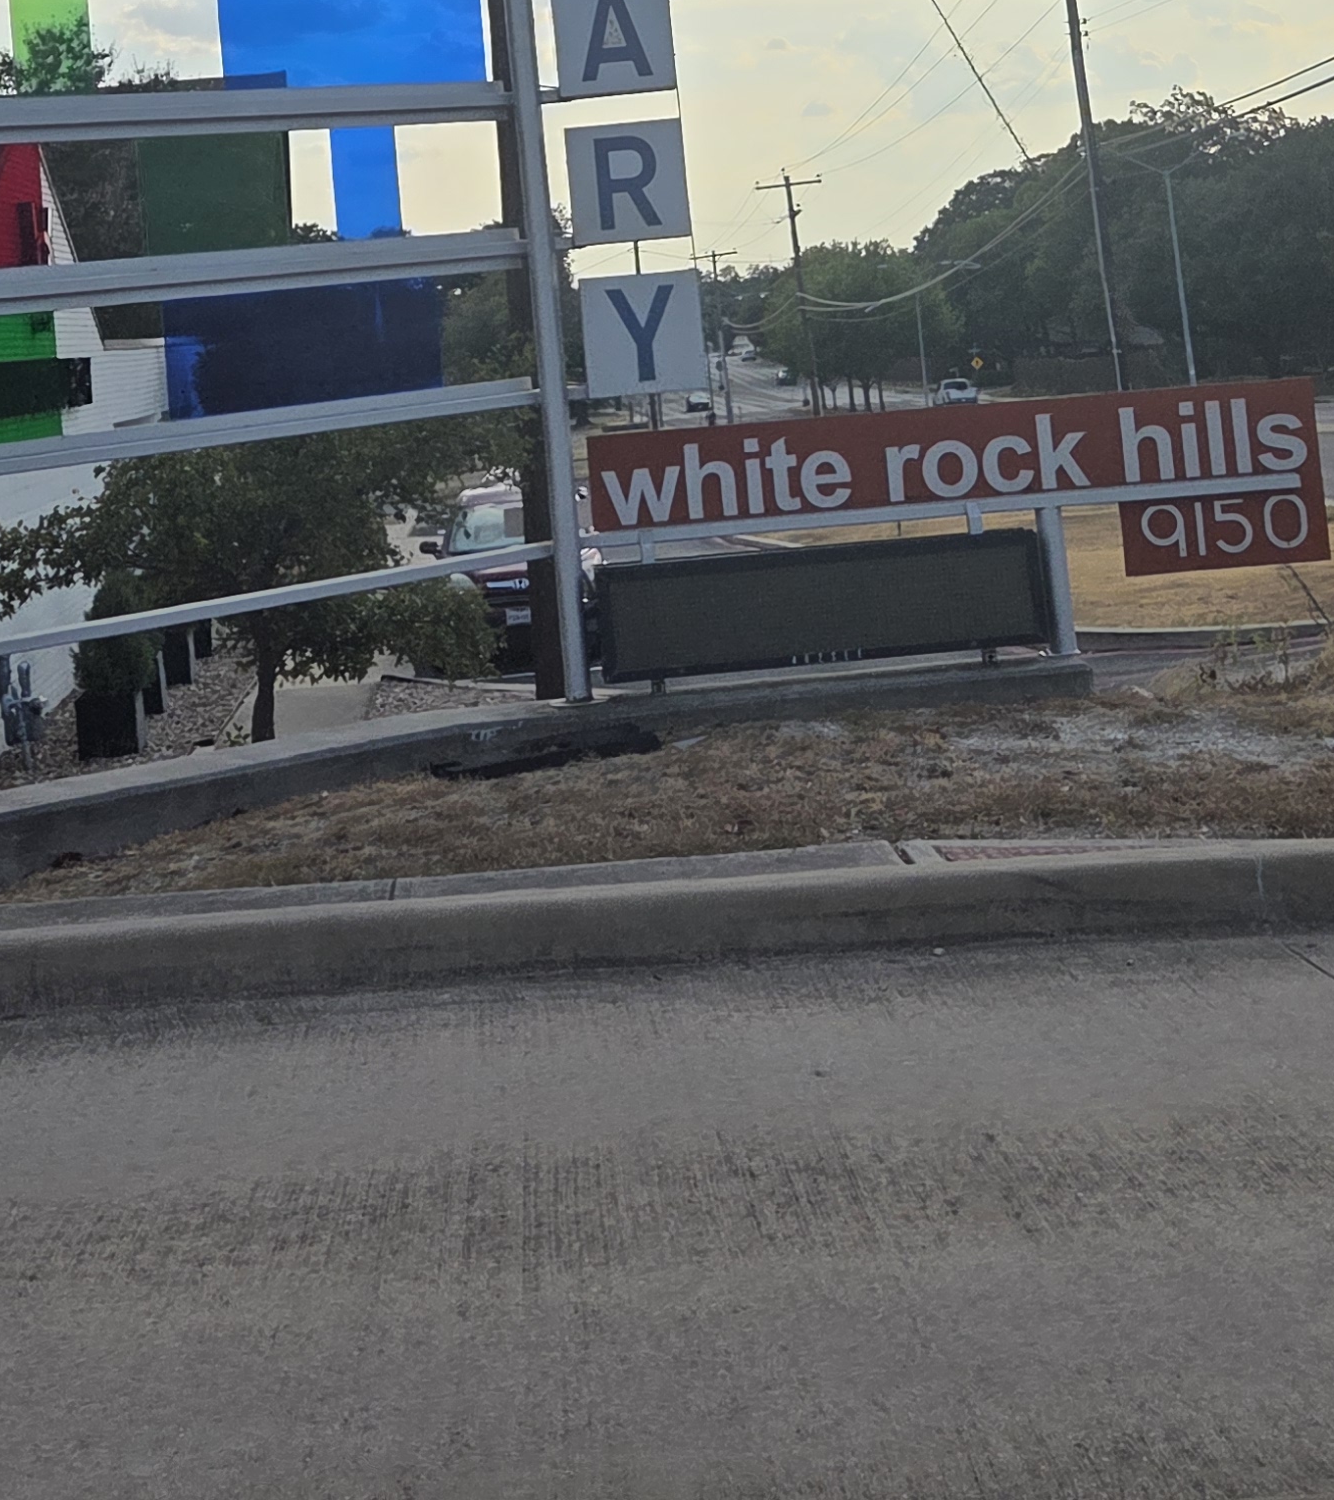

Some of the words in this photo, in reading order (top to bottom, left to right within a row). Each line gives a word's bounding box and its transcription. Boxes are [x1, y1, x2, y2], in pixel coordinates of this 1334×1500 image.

[600, 436, 852, 526] white
[884, 413, 1092, 503] rock
[1118, 398, 1308, 484] hills
[1140, 494, 1309, 558] 9150
